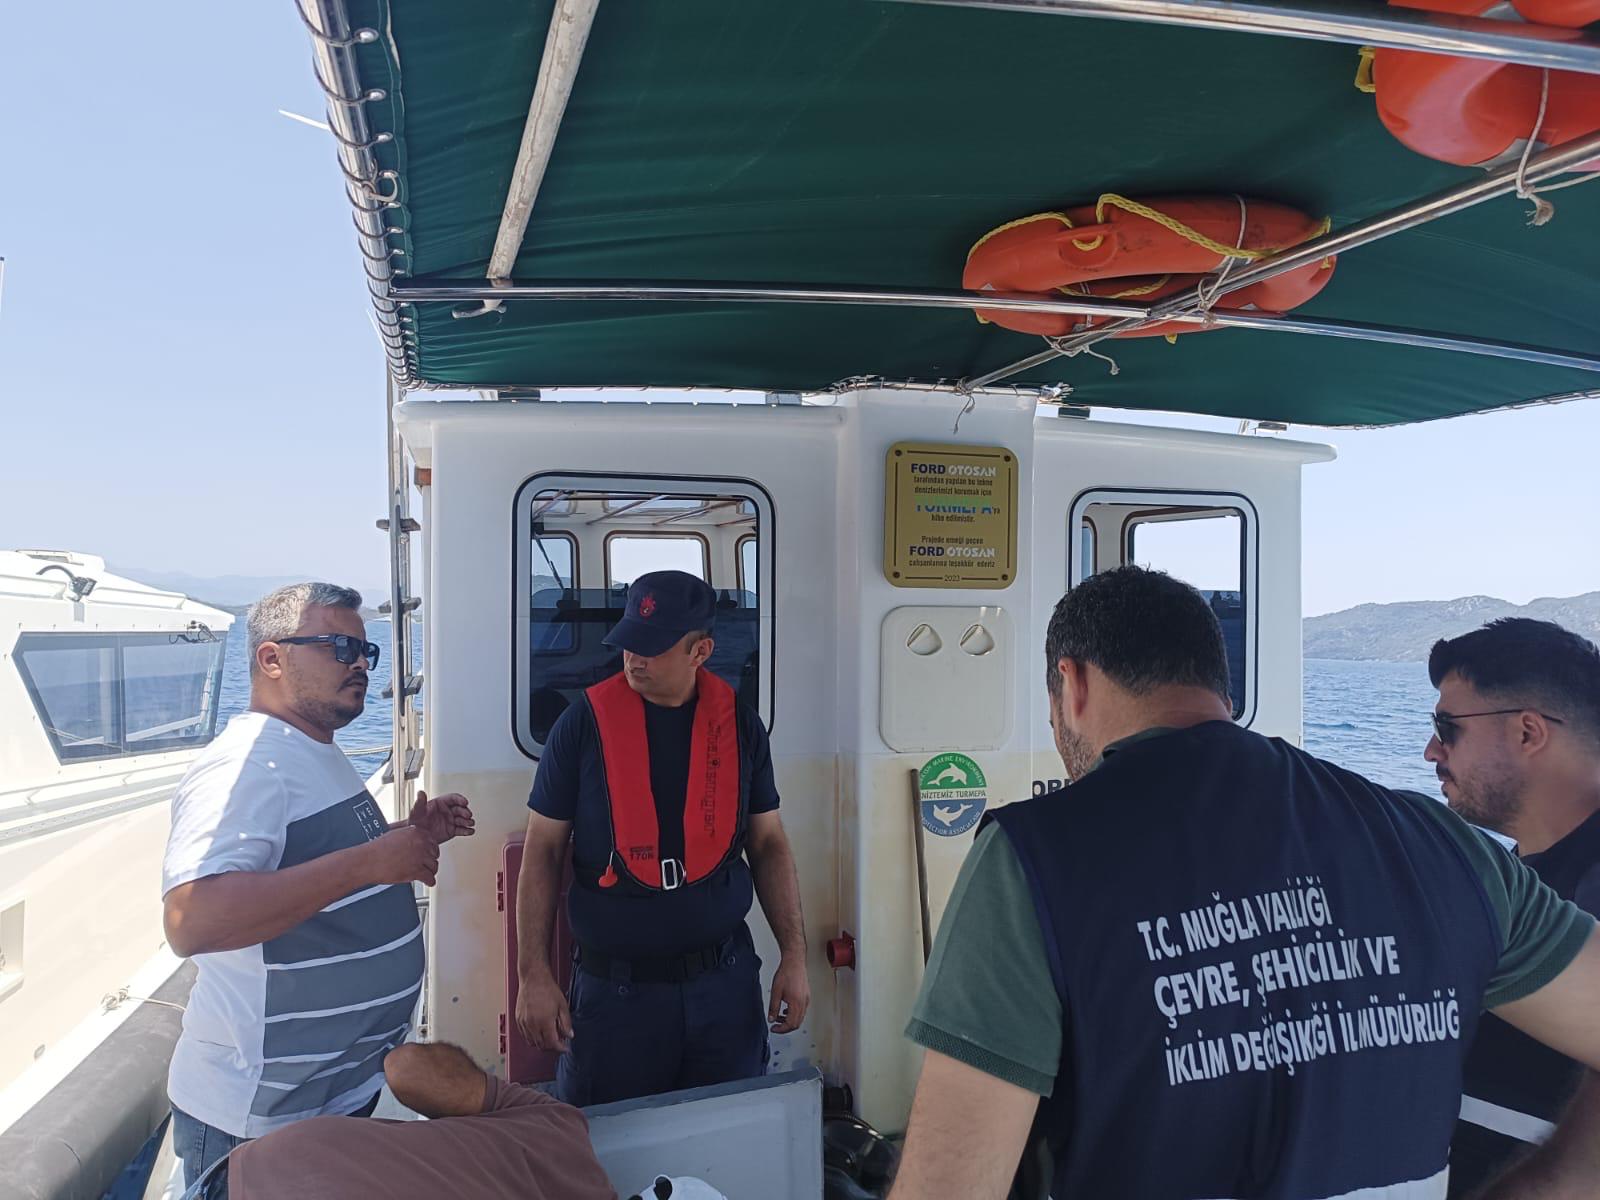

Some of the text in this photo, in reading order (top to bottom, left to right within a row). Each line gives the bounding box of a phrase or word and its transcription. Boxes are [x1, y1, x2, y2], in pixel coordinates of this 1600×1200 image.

[911, 464, 996, 476] FORD OTOSAN
[910, 546, 995, 558] FORD OTOSAN
[921, 789, 987, 799] NİZTEMİZ TURMEPA
[1137, 917, 1182, 961] T.C.
[1180, 891, 1261, 953] MUĞLA
[1154, 928, 1400, 1029] ÇEVRE, ŞEHİCİLİK VE
[1165, 1029, 1230, 1086] İKLİM
[1337, 1000, 1359, 1053] İL
[1357, 988, 1461, 1049] MÜDÜRLÜĞ
